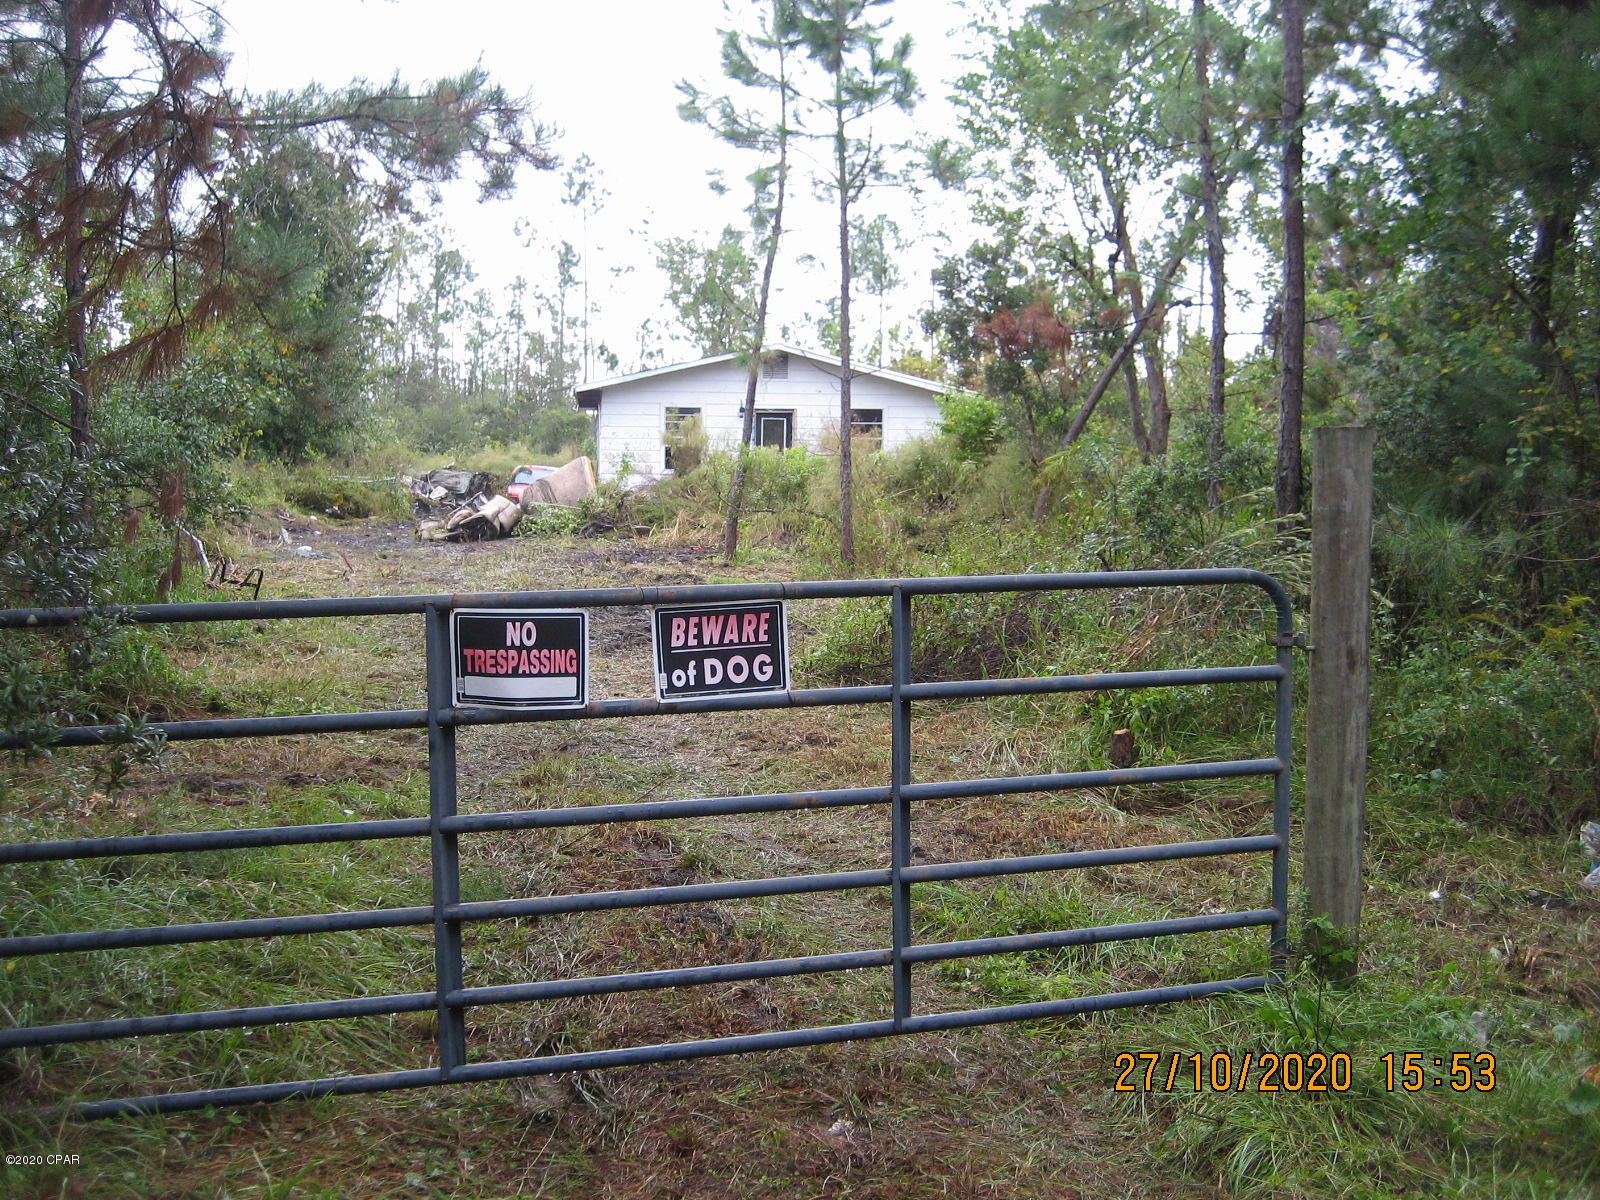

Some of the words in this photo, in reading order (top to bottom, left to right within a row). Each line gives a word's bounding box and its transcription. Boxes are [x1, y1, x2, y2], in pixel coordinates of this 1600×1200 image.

[506, 621, 537, 647] NO
[670, 612, 770, 648] BEWARE
[463, 648, 578, 675] TRESPASSING
[671, 660, 697, 688] of
[703, 653, 774, 685] DOG
